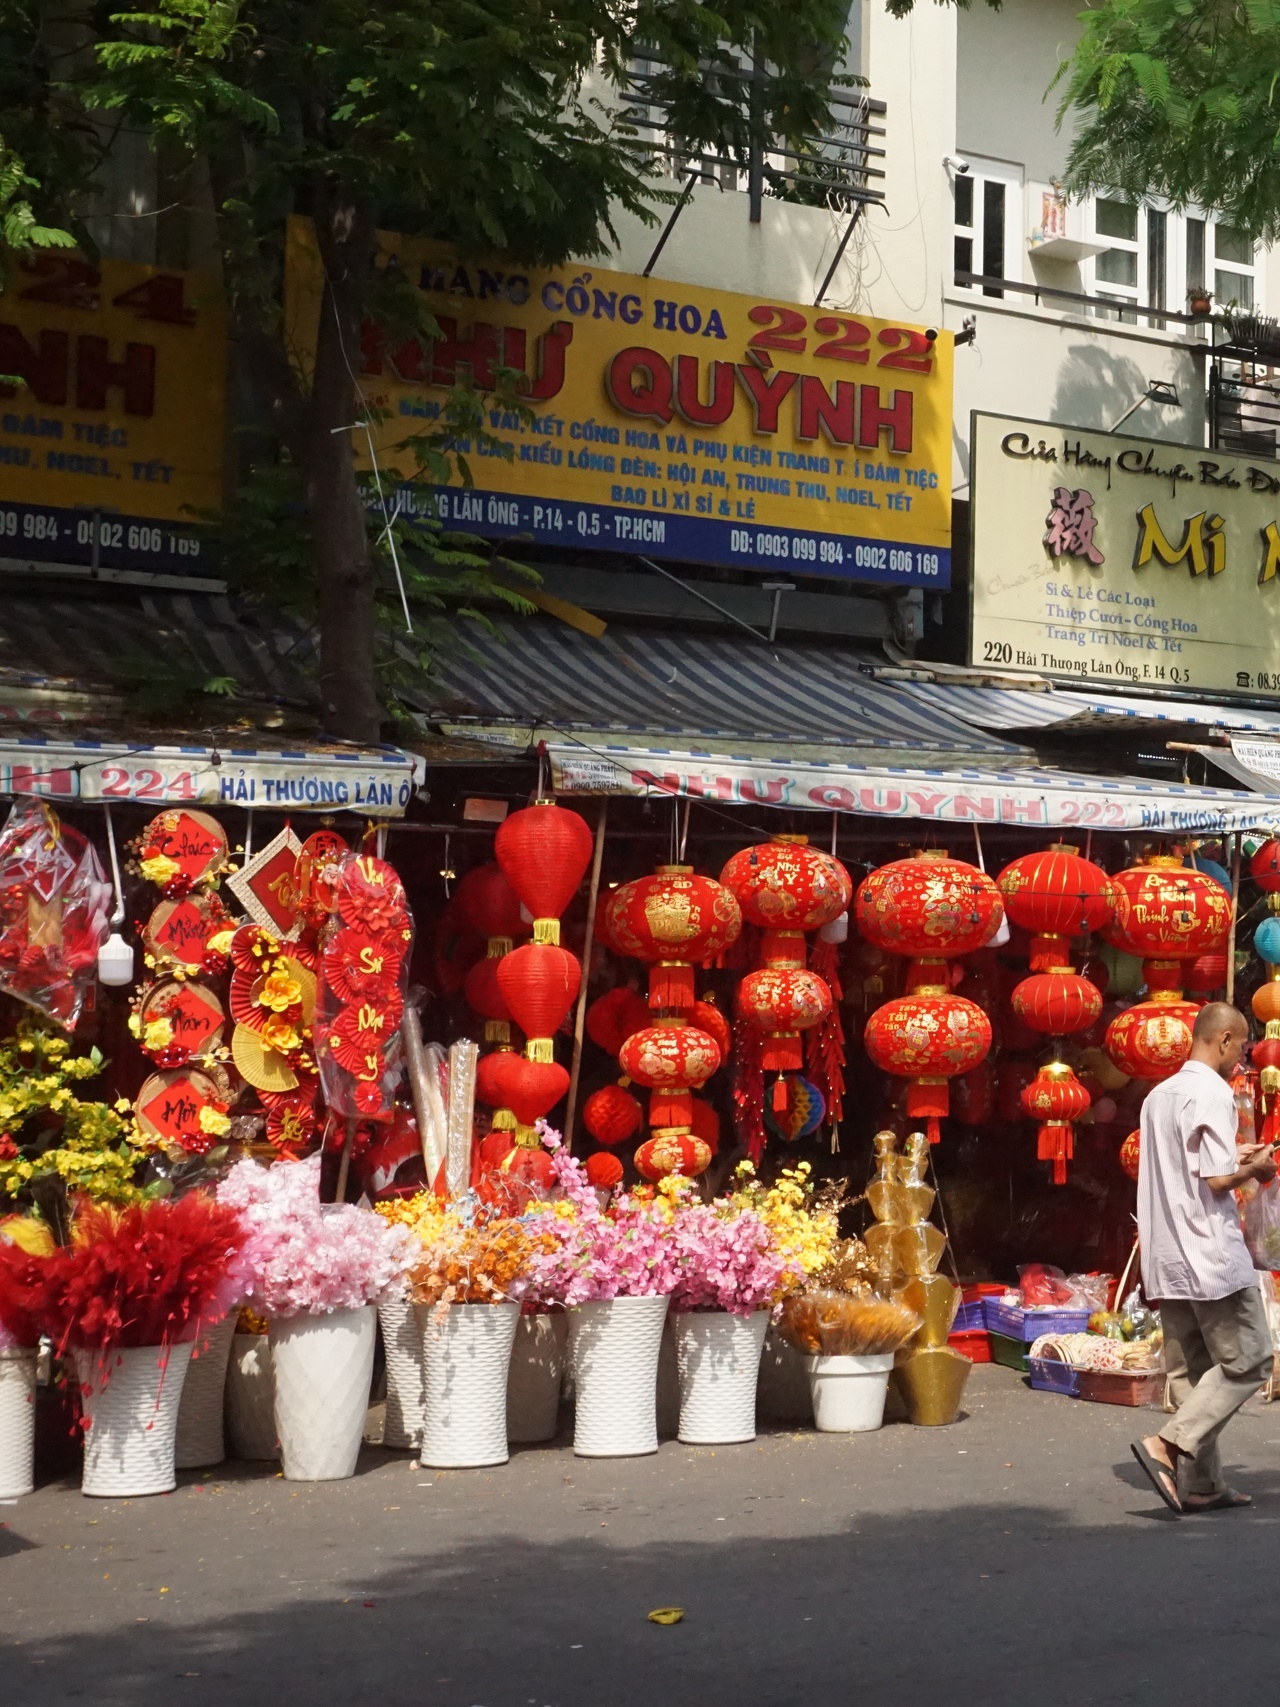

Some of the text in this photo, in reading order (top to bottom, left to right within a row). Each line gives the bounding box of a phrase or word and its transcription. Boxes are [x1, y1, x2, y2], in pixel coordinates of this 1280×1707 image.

[541, 272, 727, 340] CỔNG HOA
[748, 305, 934, 374] 222
[605, 347, 914, 455] QUỲNH
[625, 429, 660, 450] HOA
[666, 433, 688, 454] VÀ
[693, 438, 727, 463] PHỤ
[733, 444, 771, 468] KIỆN
[777, 451, 829, 474] TRANG
[905, 468, 938, 491] TIỆC
[1001, 432, 1058, 464] Cửa
[1063, 440, 1111, 491] Hàng
[1116, 449, 1195, 498] Chuyên
[1198, 460, 1243, 489] Bán
[611, 485, 647, 505] BAO
[718, 501, 730, 516] &
[667, 463, 696, 486] HỘI
[701, 469, 730, 490] AN,
[736, 473, 790, 496] TRUNG
[796, 481, 830, 503] THU,
[836, 487, 881, 510] NOEL,
[886, 490, 912, 512] TẾT
[23, 516, 58, 541] 984
[128, 525, 161, 552] 606
[453, 493, 483, 522] LÃN
[487, 496, 518, 527] ÔNG
[534, 505, 563, 531] P.14
[577, 511, 600, 535] Q.5
[614, 515, 665, 543] TP.HCM
[757, 533, 788, 558] 0903
[792, 537, 816, 561] 099
[820, 542, 843, 564] 984
[856, 545, 886, 570] 0902
[890, 550, 913, 573] 606
[917, 553, 939, 576] 169
[1132, 502, 1226, 579] Mi
[1046, 603, 1086, 624] Thiệp
[1089, 608, 1122, 625] Cưới
[1172, 618, 1198, 633] Hoa
[1061, 585, 1073, 598] &
[1097, 589, 1121, 604] Các
[1125, 592, 1156, 609] Loại
[983, 640, 1012, 663] 220
[1016, 650, 1037, 667] Hải
[1041, 652, 1088, 677] Thượng
[1115, 659, 1141, 682] Ông,
[1143, 664, 1151, 679] F.
[1154, 665, 1165, 680] 14
[1046, 625, 1085, 647] Trang
[1089, 628, 1109, 645] Trí
[1146, 636, 1158, 651] &
[1162, 636, 1183, 654] Tết
[100, 767, 200, 799] 224
[221, 768, 392, 806] HẢI THƯỢNG LÃN
[631, 770, 1129, 826] NHƯ QUỲNH 222
[1141, 803, 1165, 829] HẢI
[1170, 809, 1227, 831] THƯỢNG
